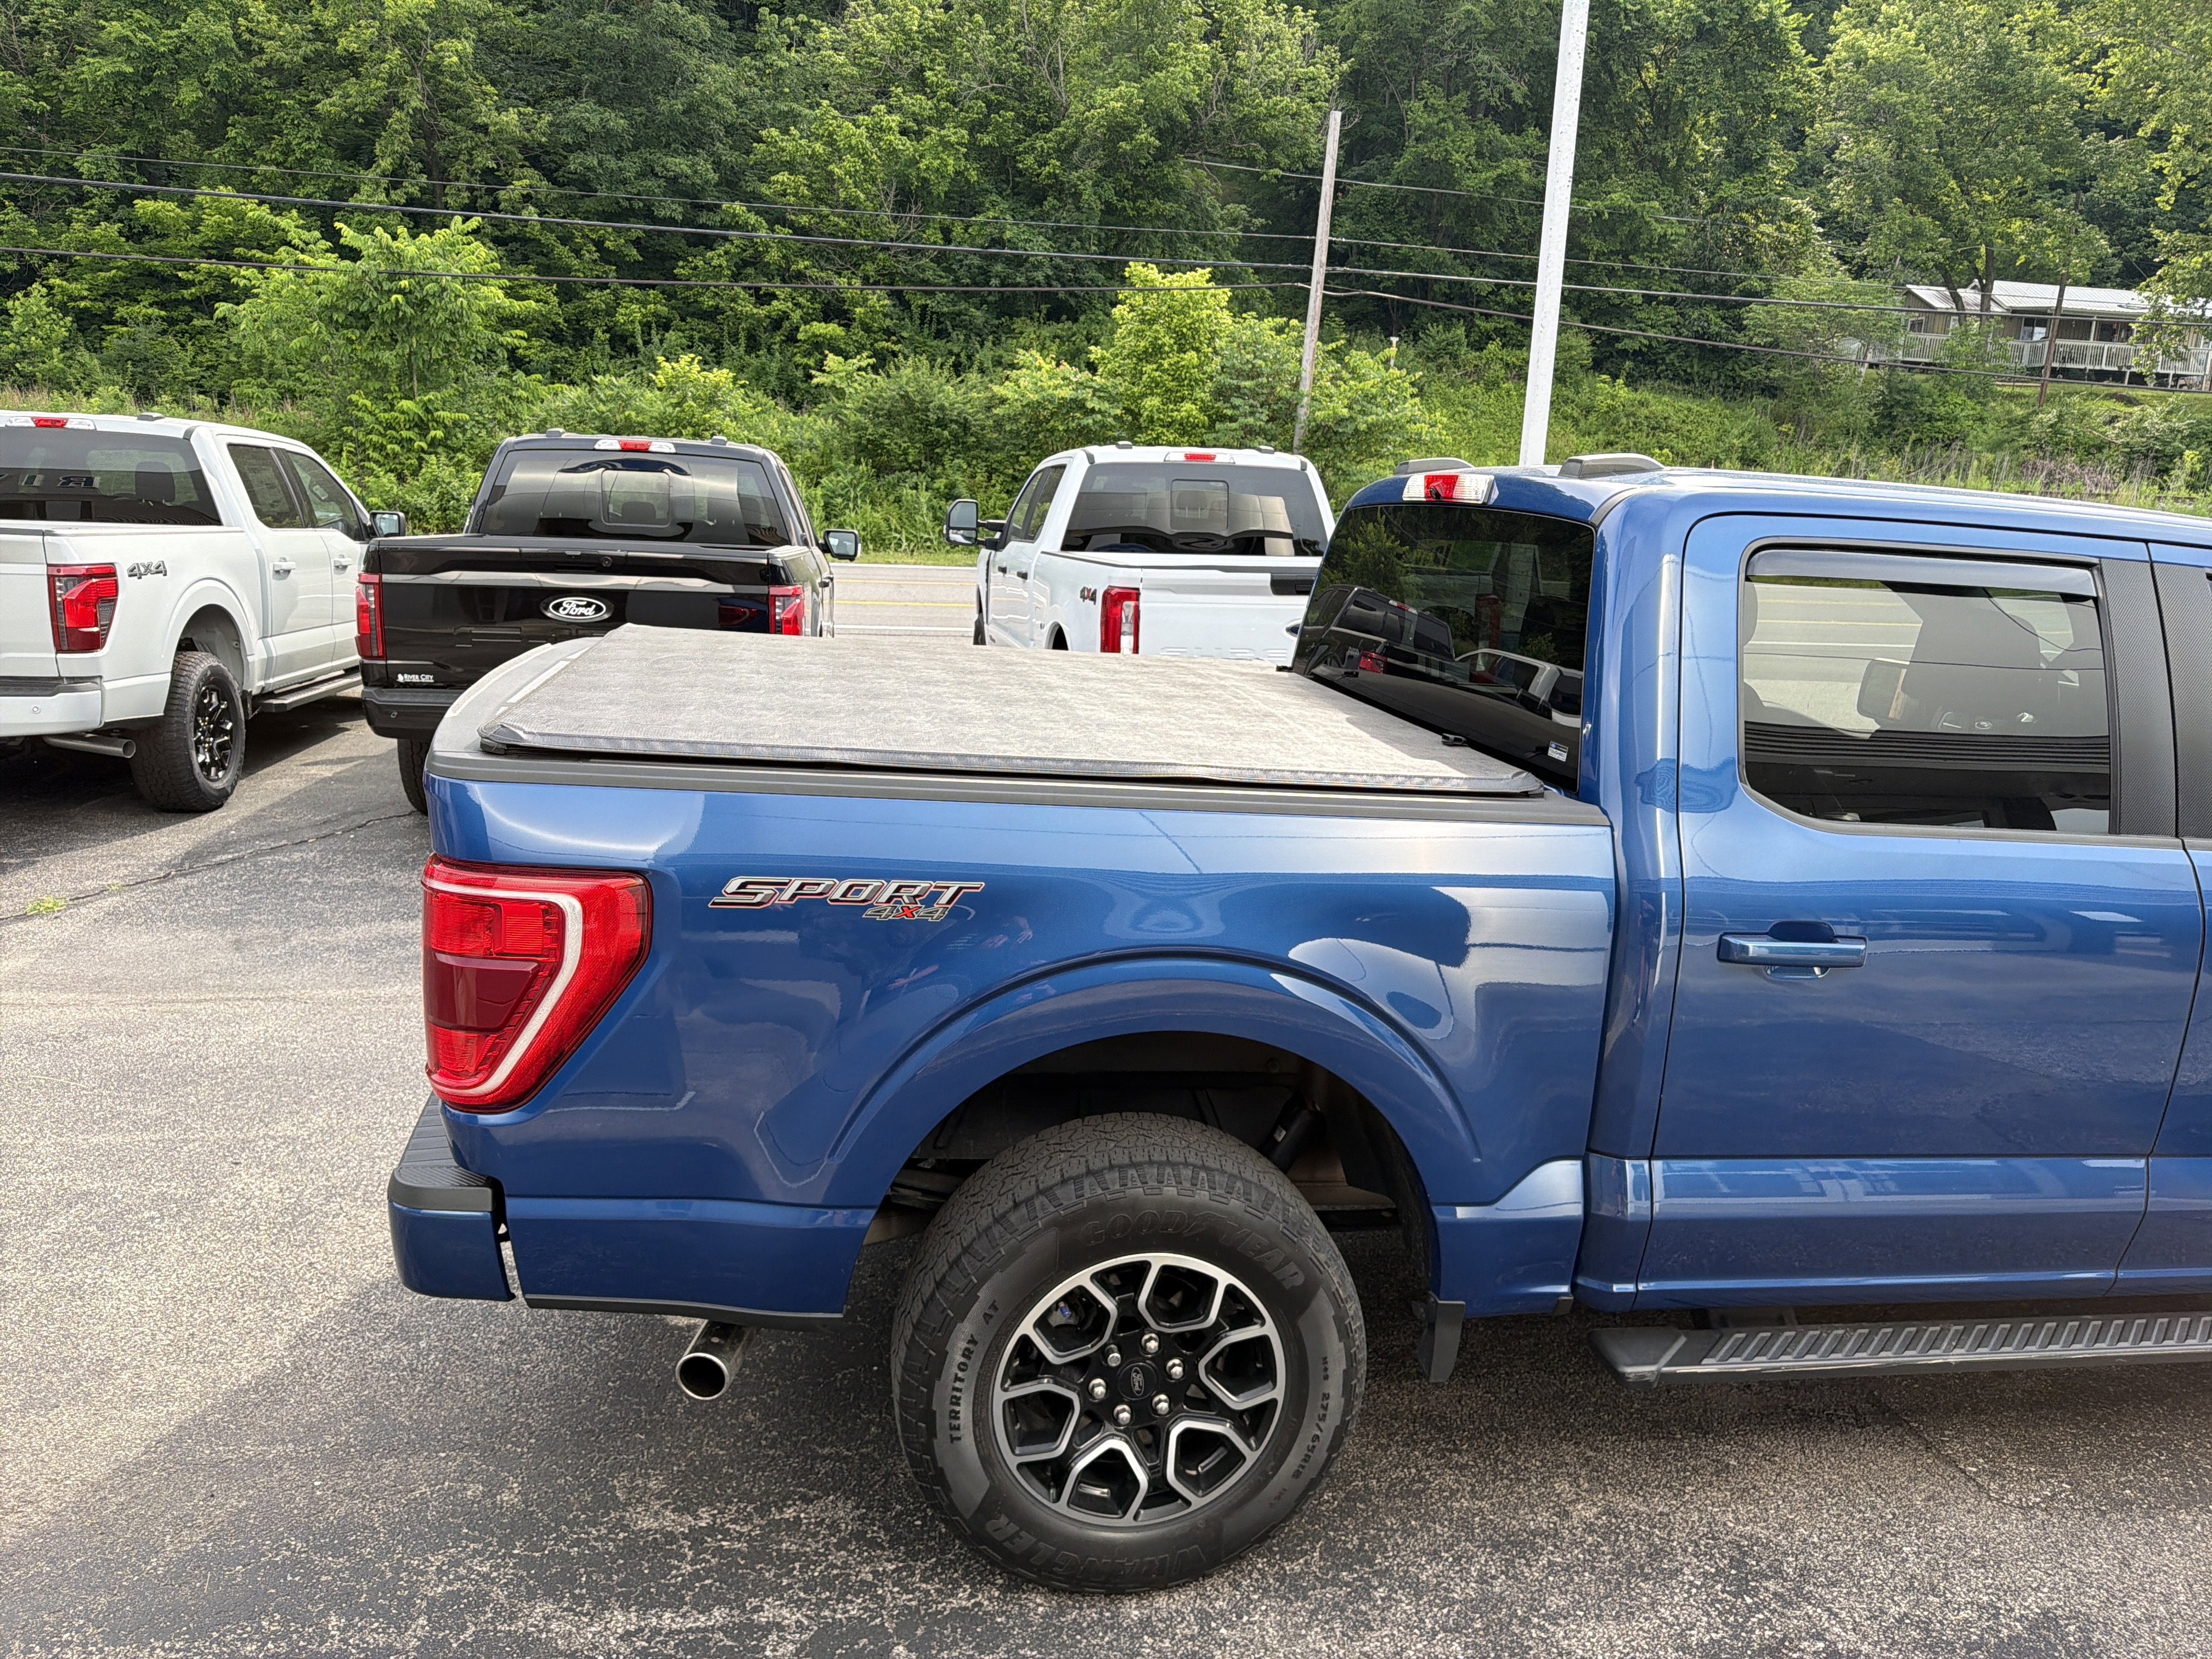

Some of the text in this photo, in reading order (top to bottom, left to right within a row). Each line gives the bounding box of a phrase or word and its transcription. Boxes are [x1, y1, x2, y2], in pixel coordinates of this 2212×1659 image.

[127, 560, 167, 579] 4x4
[559, 600, 596, 616] Ford
[708, 876, 985, 909] SPORT
[862, 904, 951, 922] 4x4
[1080, 1210, 1306, 1290] GOODYEAR
[949, 1299, 999, 1444] TERRITORY AT
[985, 1513, 1207, 1581] WRANGLER
